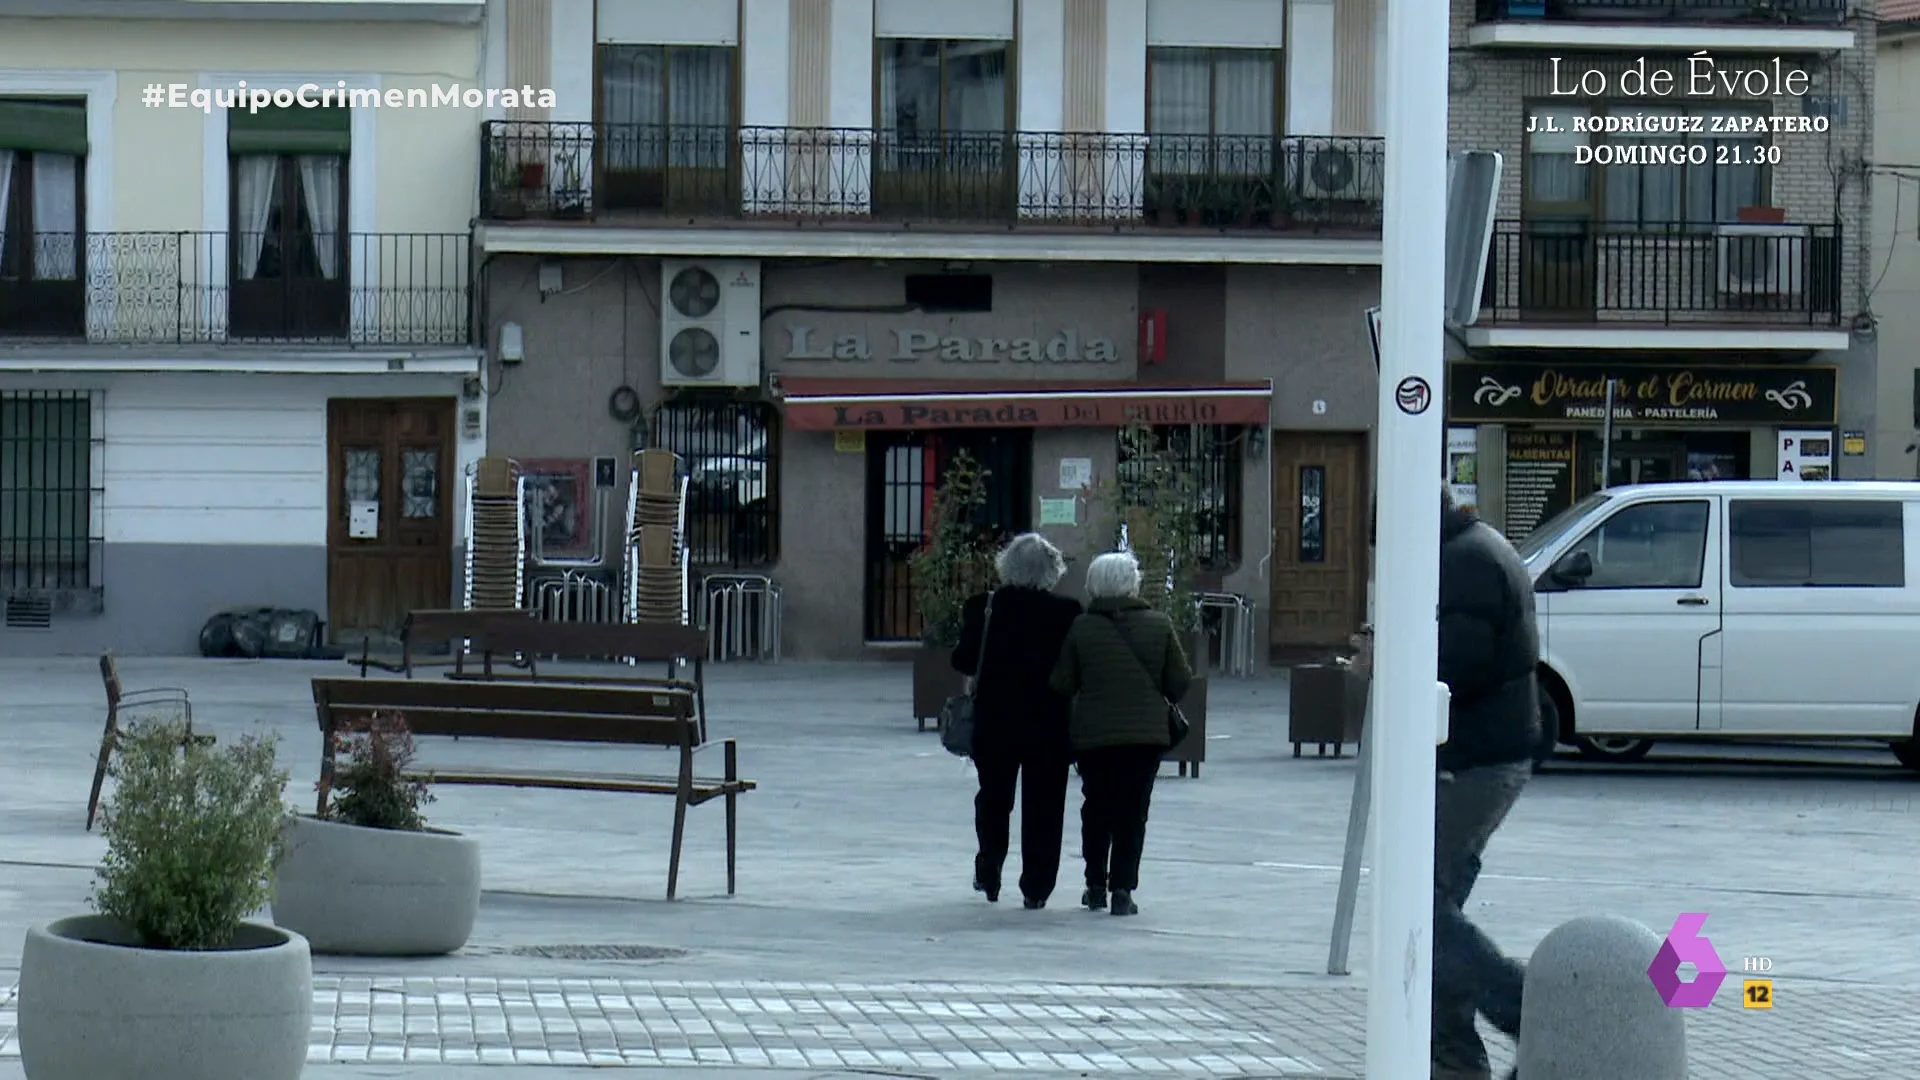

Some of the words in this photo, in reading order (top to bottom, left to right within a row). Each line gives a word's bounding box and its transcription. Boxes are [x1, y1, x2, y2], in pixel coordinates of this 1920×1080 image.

[785, 325, 872, 362] La
[890, 327, 1120, 364] Parada
[1530, 368, 1632, 406] Obradr
[1637, 372, 1660, 400] el
[1668, 370, 1758, 406] Carmen
[834, 406, 886, 426] La
[900, 404, 1039, 425] Parada
[1566, 406, 1633, 418] PANEDRÍA
[1645, 406, 1718, 418] PASTELERÍA
